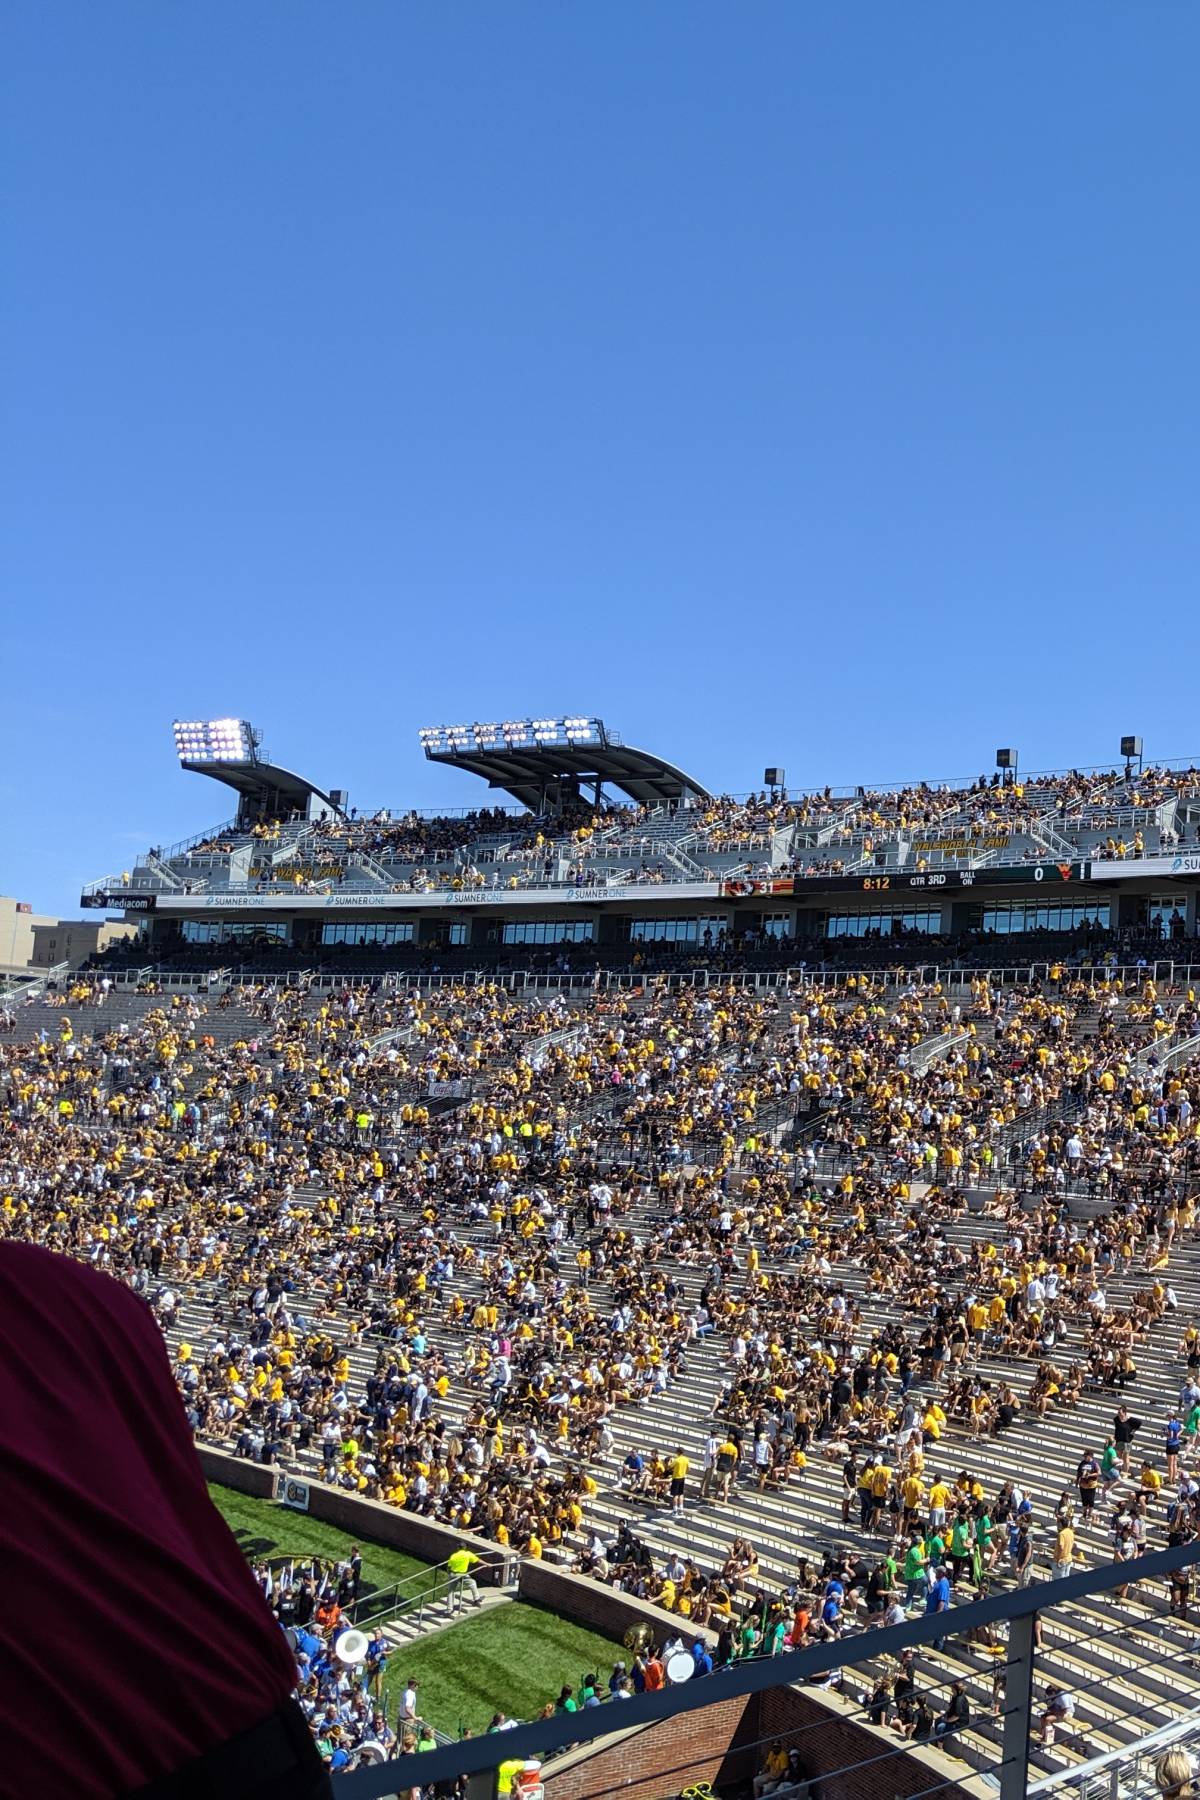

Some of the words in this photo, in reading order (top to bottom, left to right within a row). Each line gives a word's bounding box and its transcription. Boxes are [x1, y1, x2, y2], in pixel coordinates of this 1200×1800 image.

[910, 877, 926, 886] QTR
[928, 874, 946, 885] 3RD
[960, 871, 976, 879] BALL
[1034, 867, 1044, 881] 0
[759, 882, 774, 894] 31
[863, 877, 890, 890] 8:12
[107, 898, 148, 909] Mediacom
